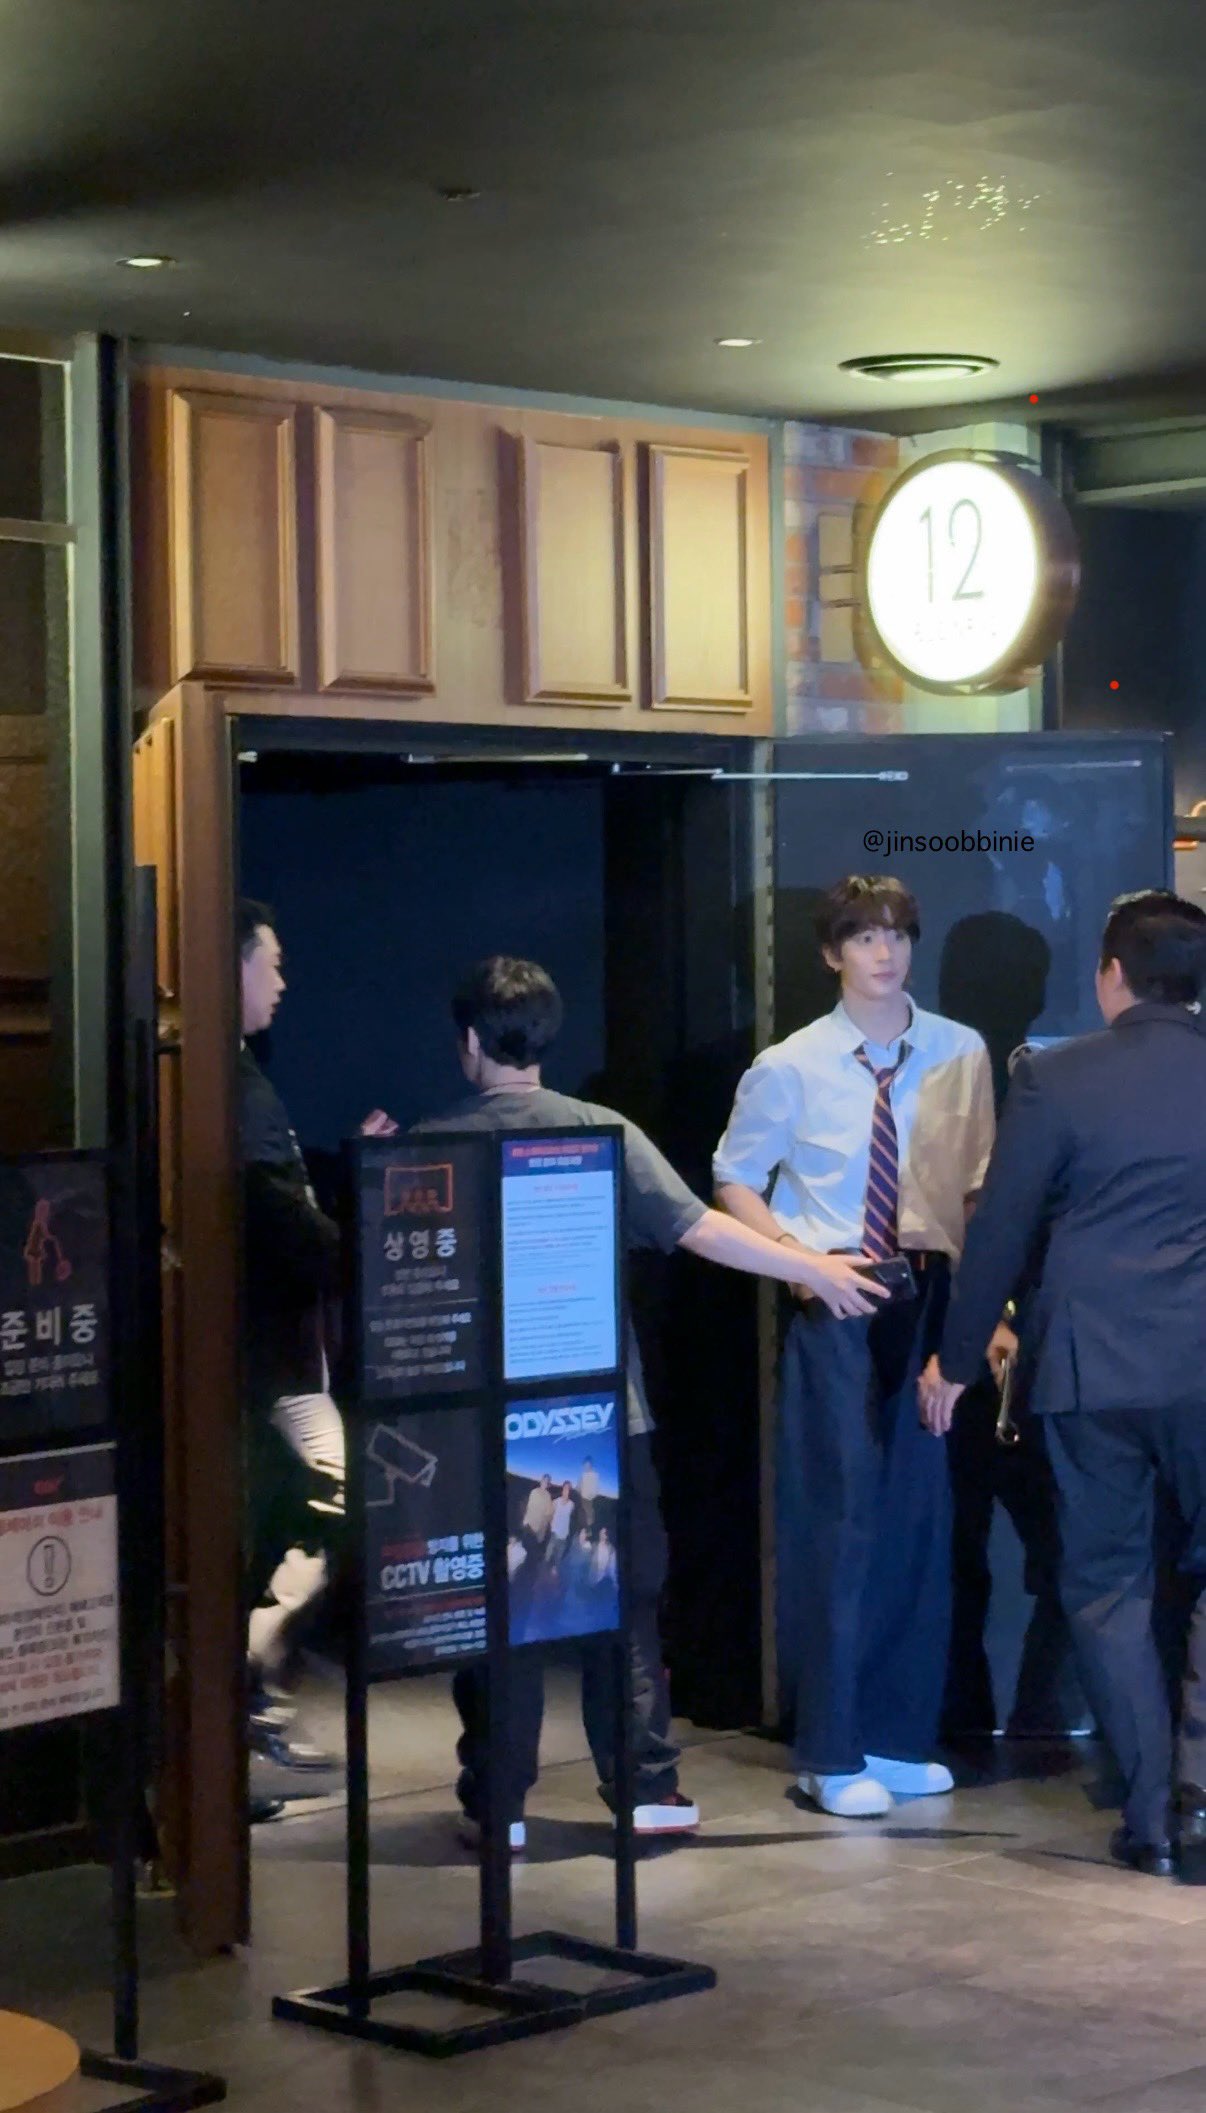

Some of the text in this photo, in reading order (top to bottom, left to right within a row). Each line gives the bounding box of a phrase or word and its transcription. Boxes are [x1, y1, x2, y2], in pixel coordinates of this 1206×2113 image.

[919, 498, 985, 603] 12
[383, 1227, 458, 1261] 상영중
[504, 1402, 615, 1440] ODYSSEY
[380, 1558, 431, 1591] CCTV
